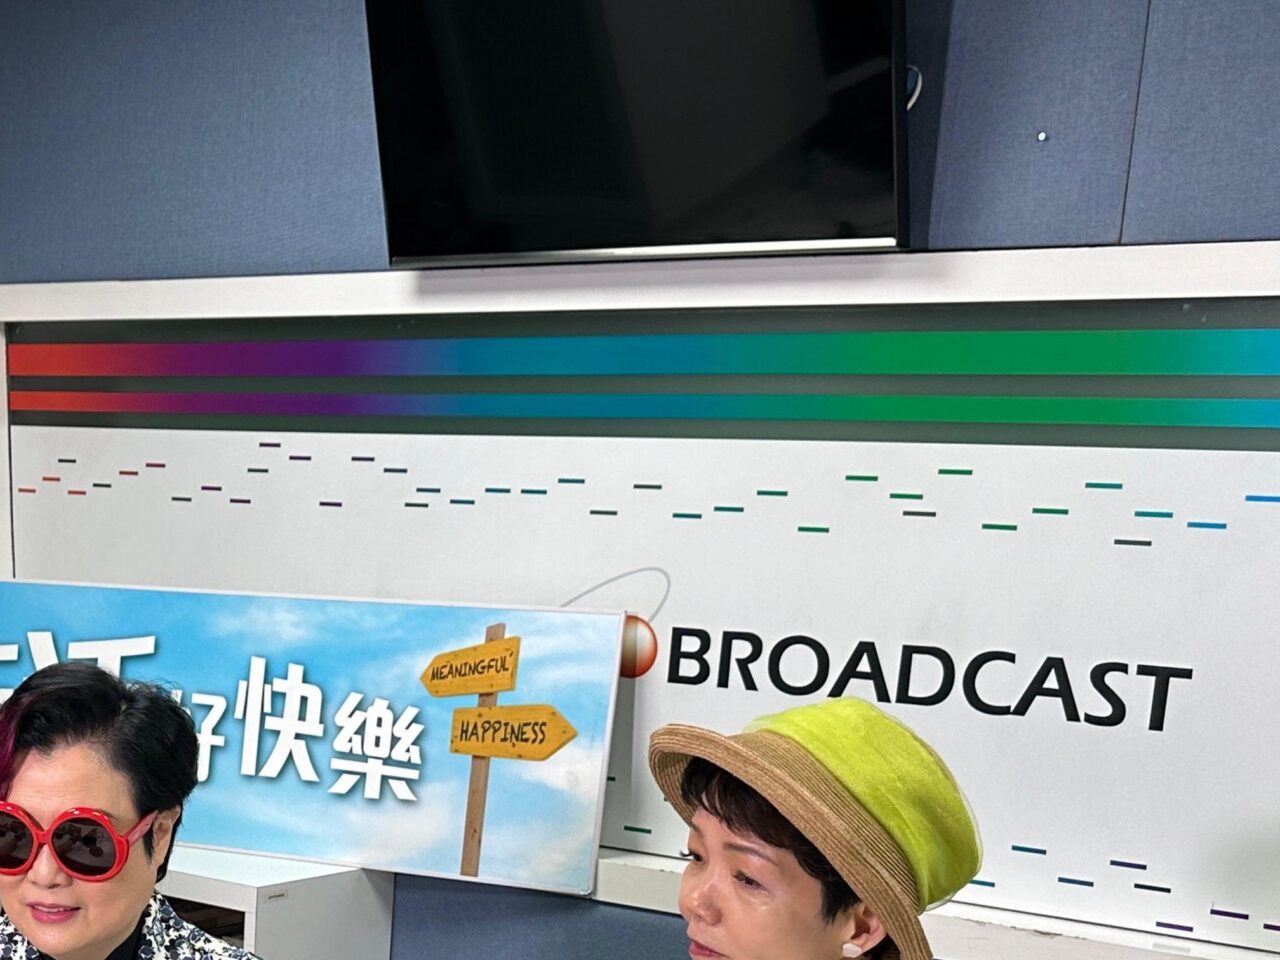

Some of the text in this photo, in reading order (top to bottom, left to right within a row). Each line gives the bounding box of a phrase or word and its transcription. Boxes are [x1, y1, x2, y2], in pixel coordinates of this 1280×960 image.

[430, 657, 510, 682] MEANINGFUL
[667, 626, 1193, 732] BROADCAST
[460, 719, 547, 745] HAPPINESS
